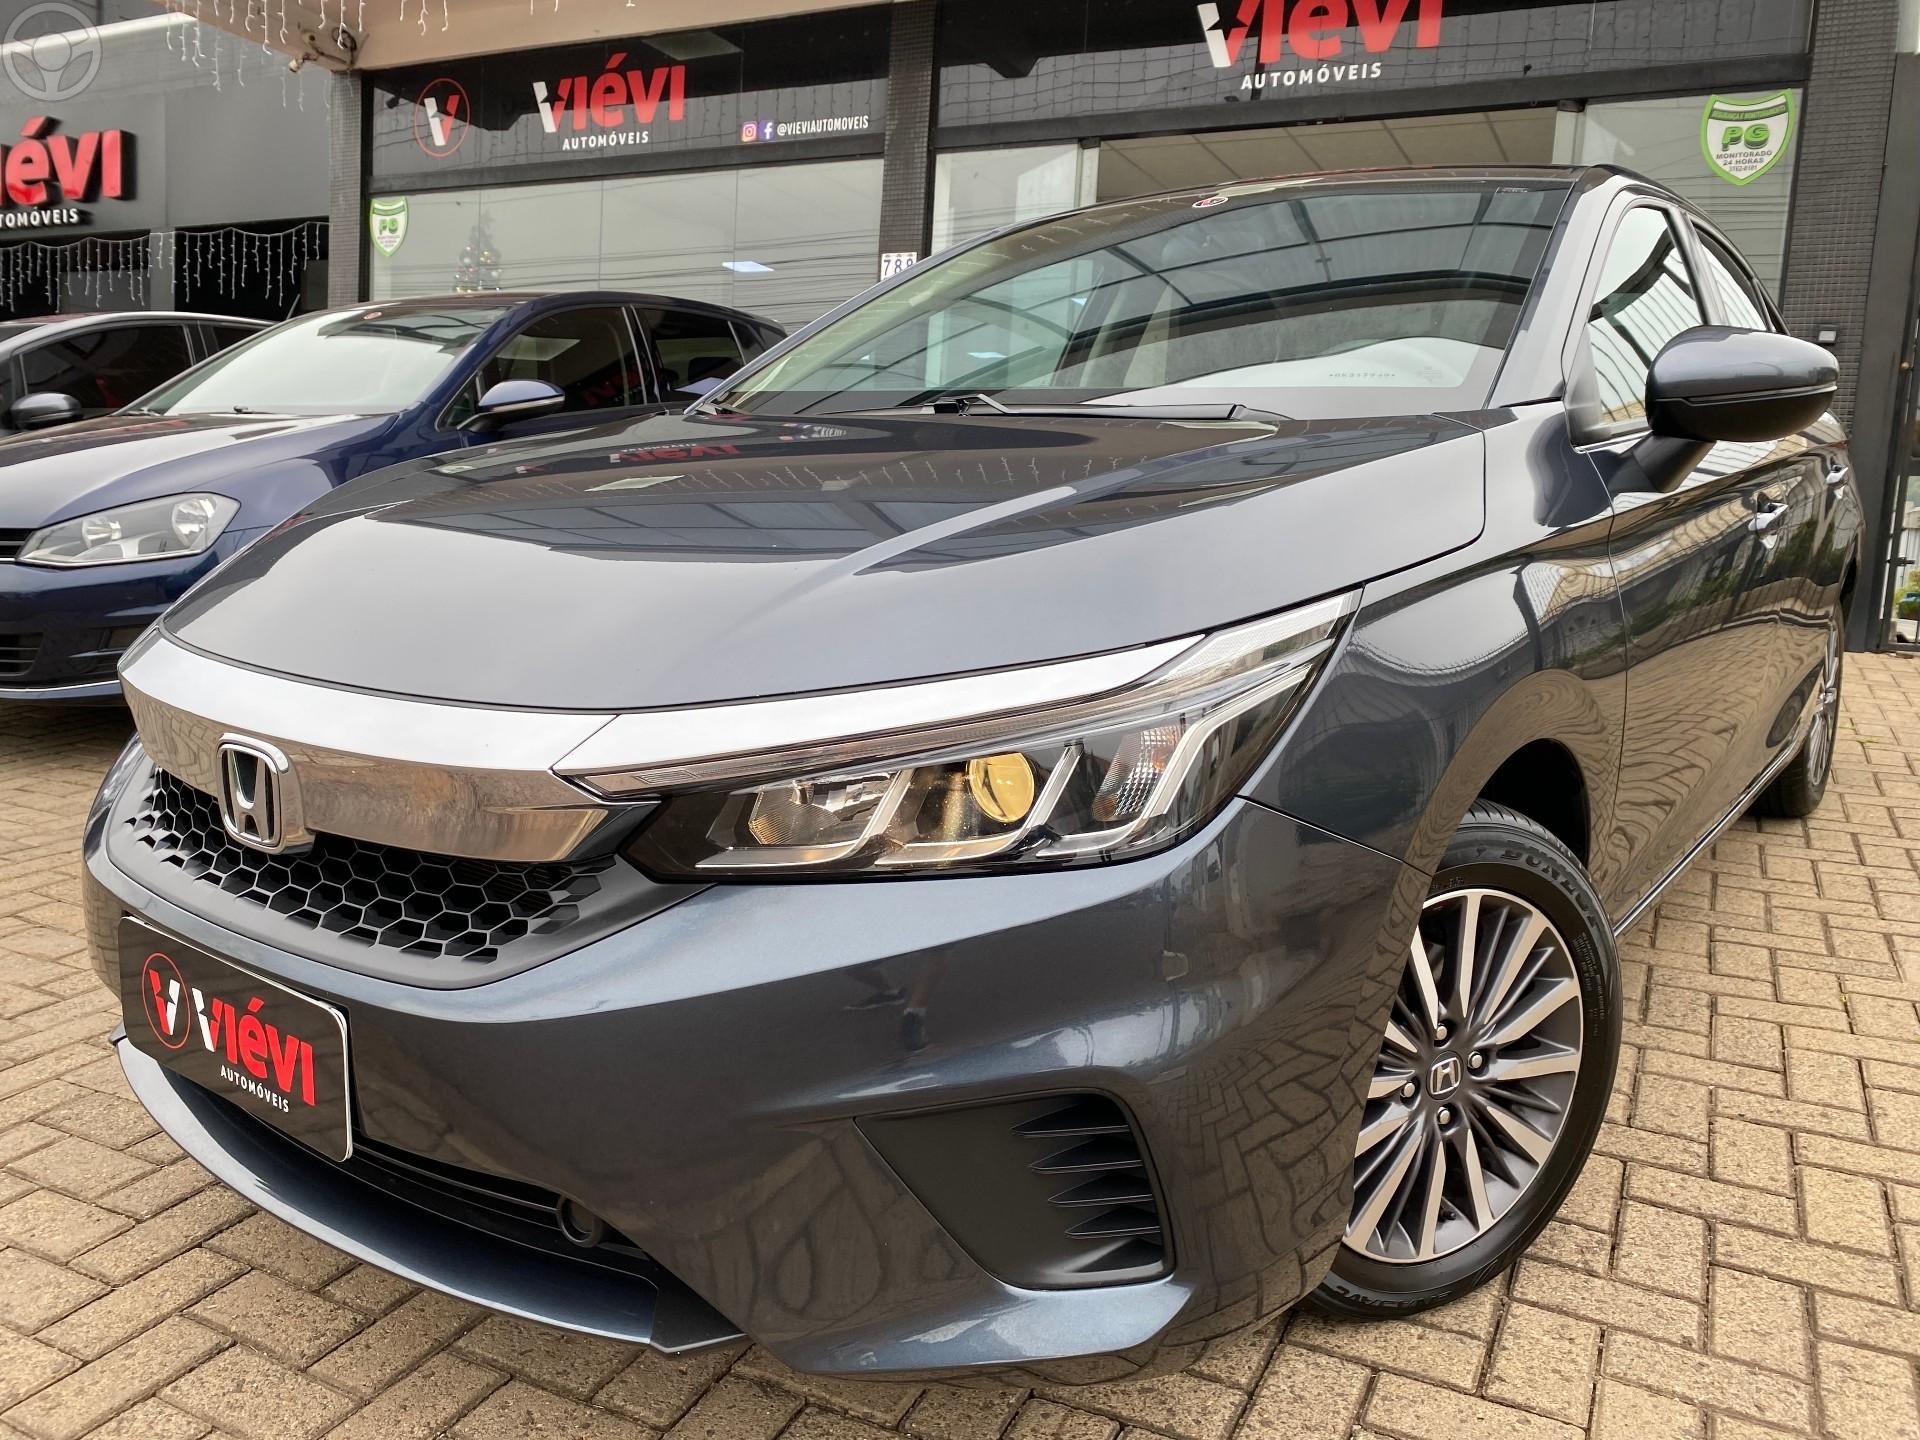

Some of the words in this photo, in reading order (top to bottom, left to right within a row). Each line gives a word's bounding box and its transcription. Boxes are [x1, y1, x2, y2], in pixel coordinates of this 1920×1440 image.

[1240, 62, 1383, 89] AUTOMÓVEIS
[777, 115, 869, 136] @VIEVIAUTOMOVEIS
[562, 131, 649, 150] AUTOMÓVEIS
[1716, 150, 1772, 160] MONITORADO
[219, 1064, 290, 1113] AUTOMÓVEIS
